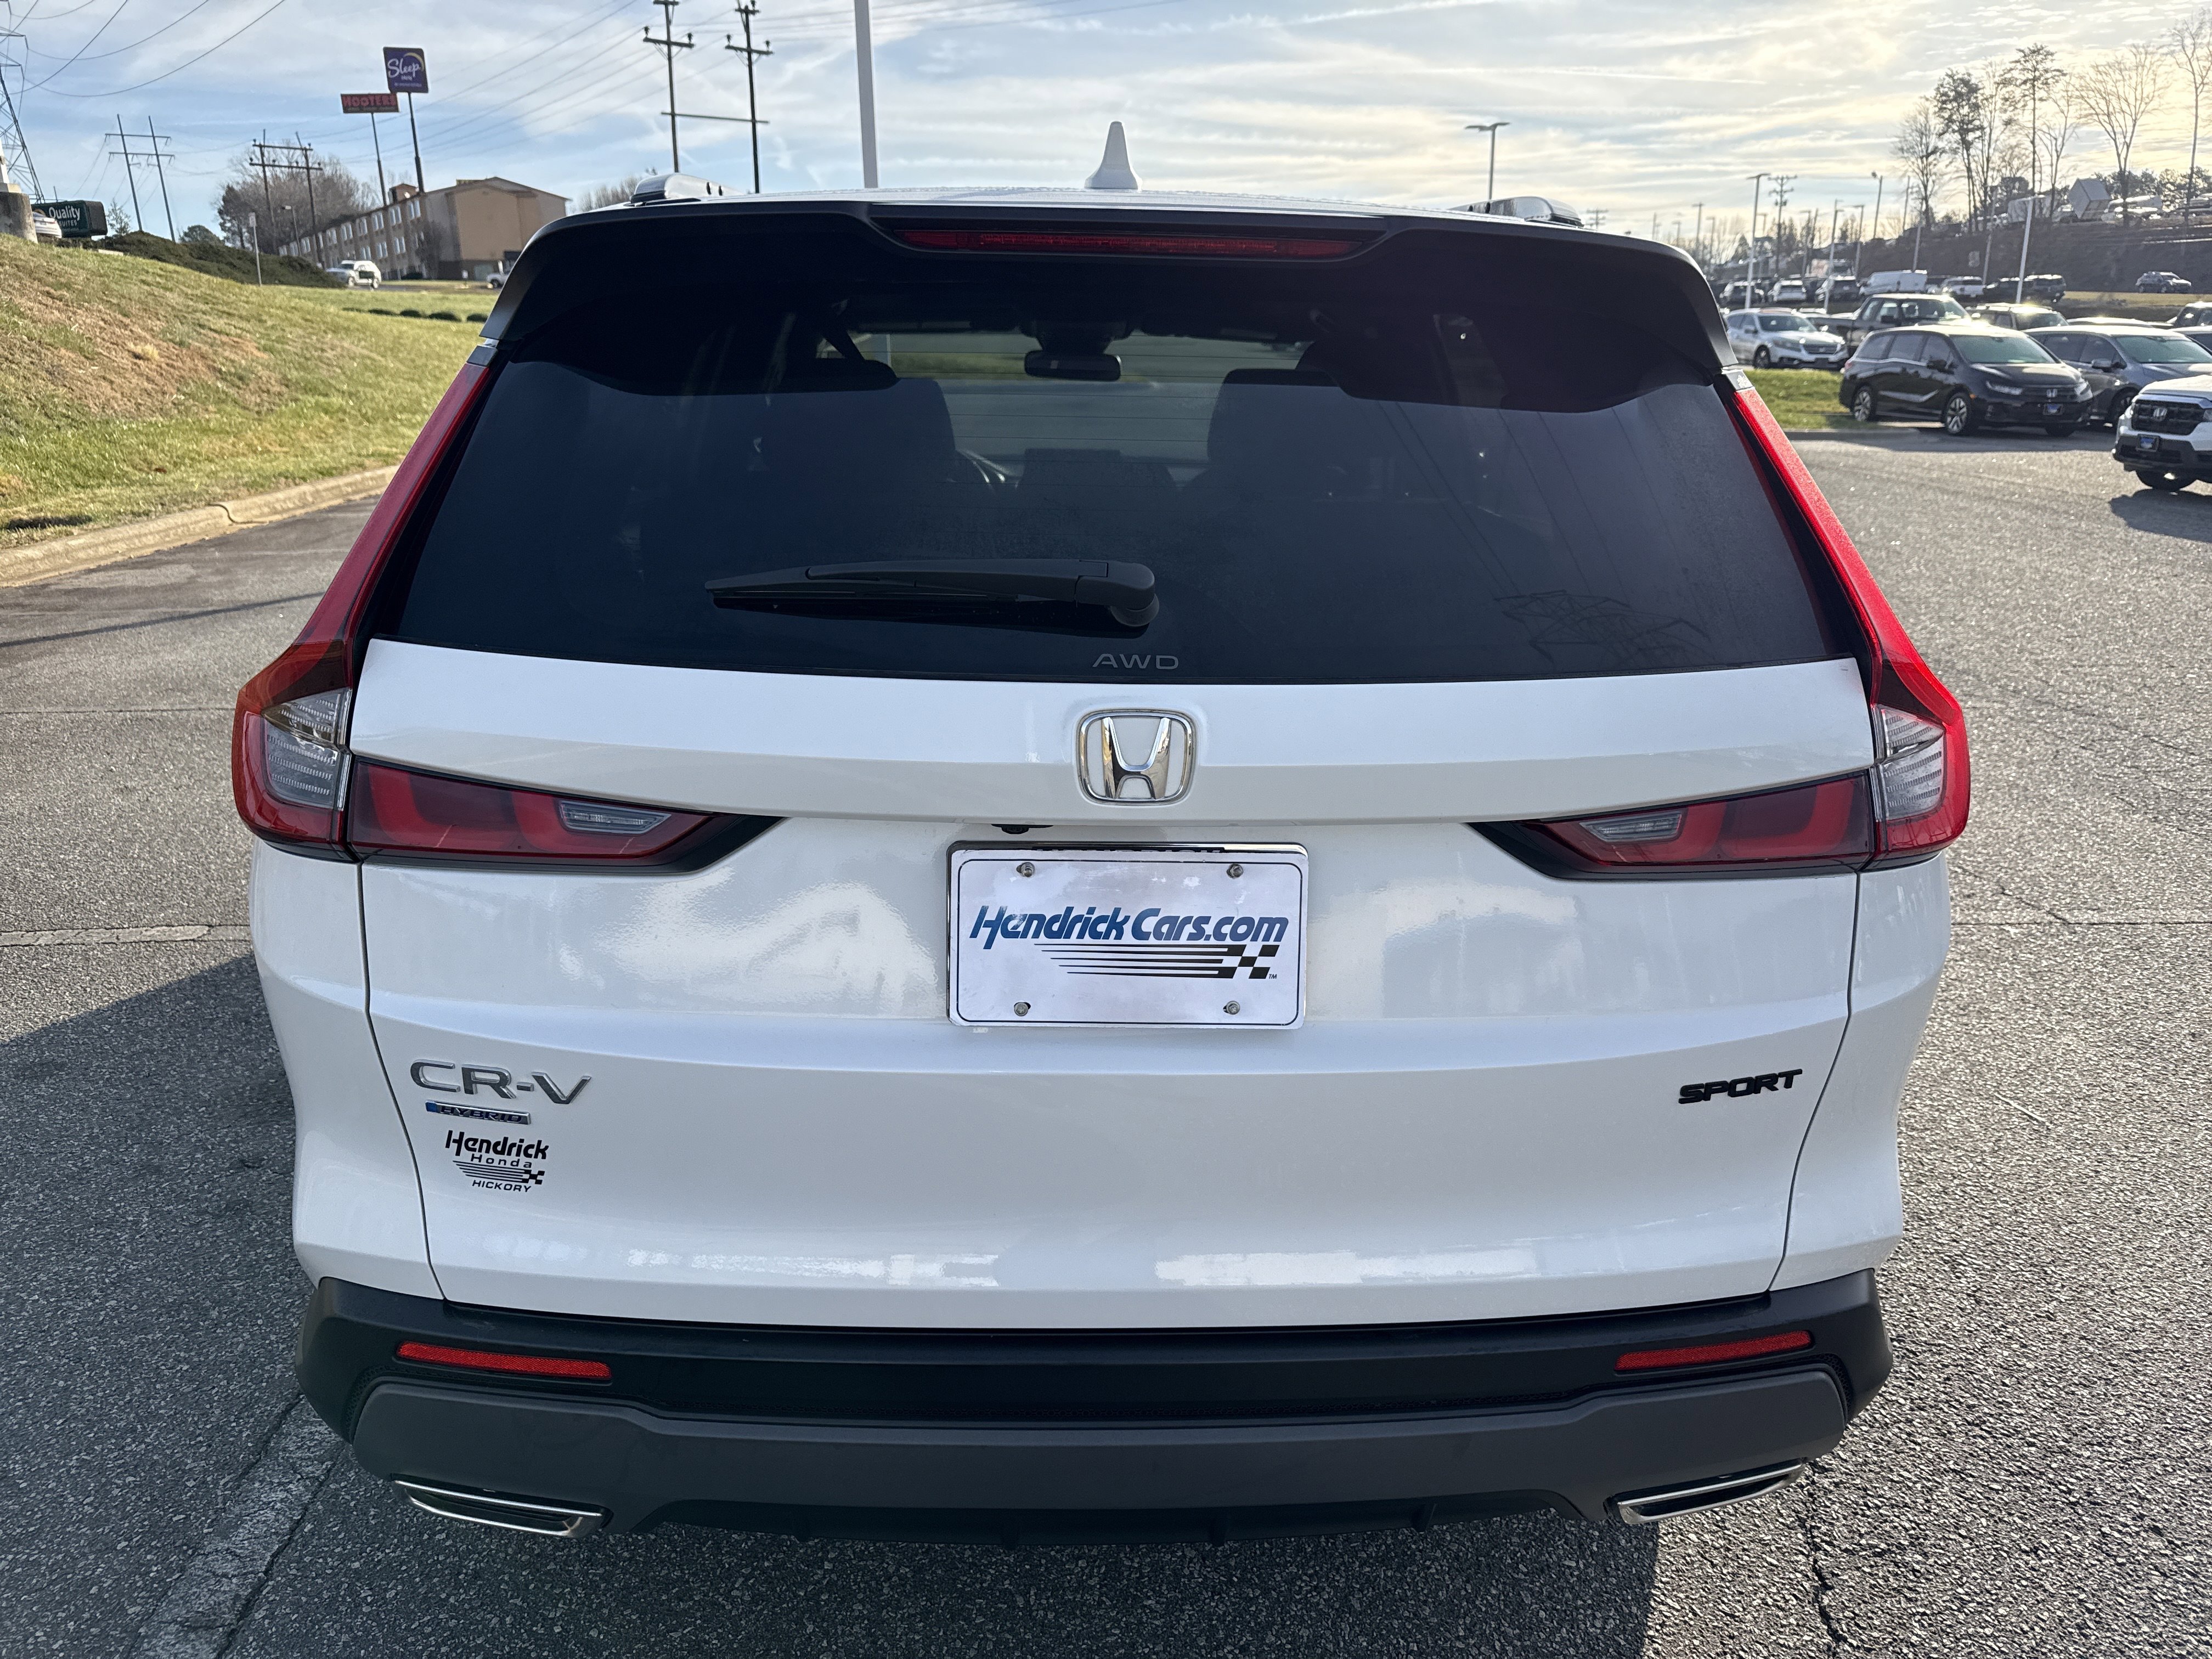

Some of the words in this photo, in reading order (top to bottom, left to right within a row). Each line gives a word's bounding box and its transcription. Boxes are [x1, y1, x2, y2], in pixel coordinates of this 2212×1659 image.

[387, 58, 420, 77] Sleep
[342, 95, 395, 106] HOOTERS
[49, 205, 80, 221] Quality
[1092, 653, 1179, 670] AWD
[410, 1059, 592, 1104] CR-V
[1678, 1069, 1803, 1104] SPORT
[441, 1105, 523, 1123] HYBRID
[445, 1130, 549, 1160] Hendrick
[471, 1153, 532, 1169] Honda
[472, 1180, 532, 1193] HICKORY
